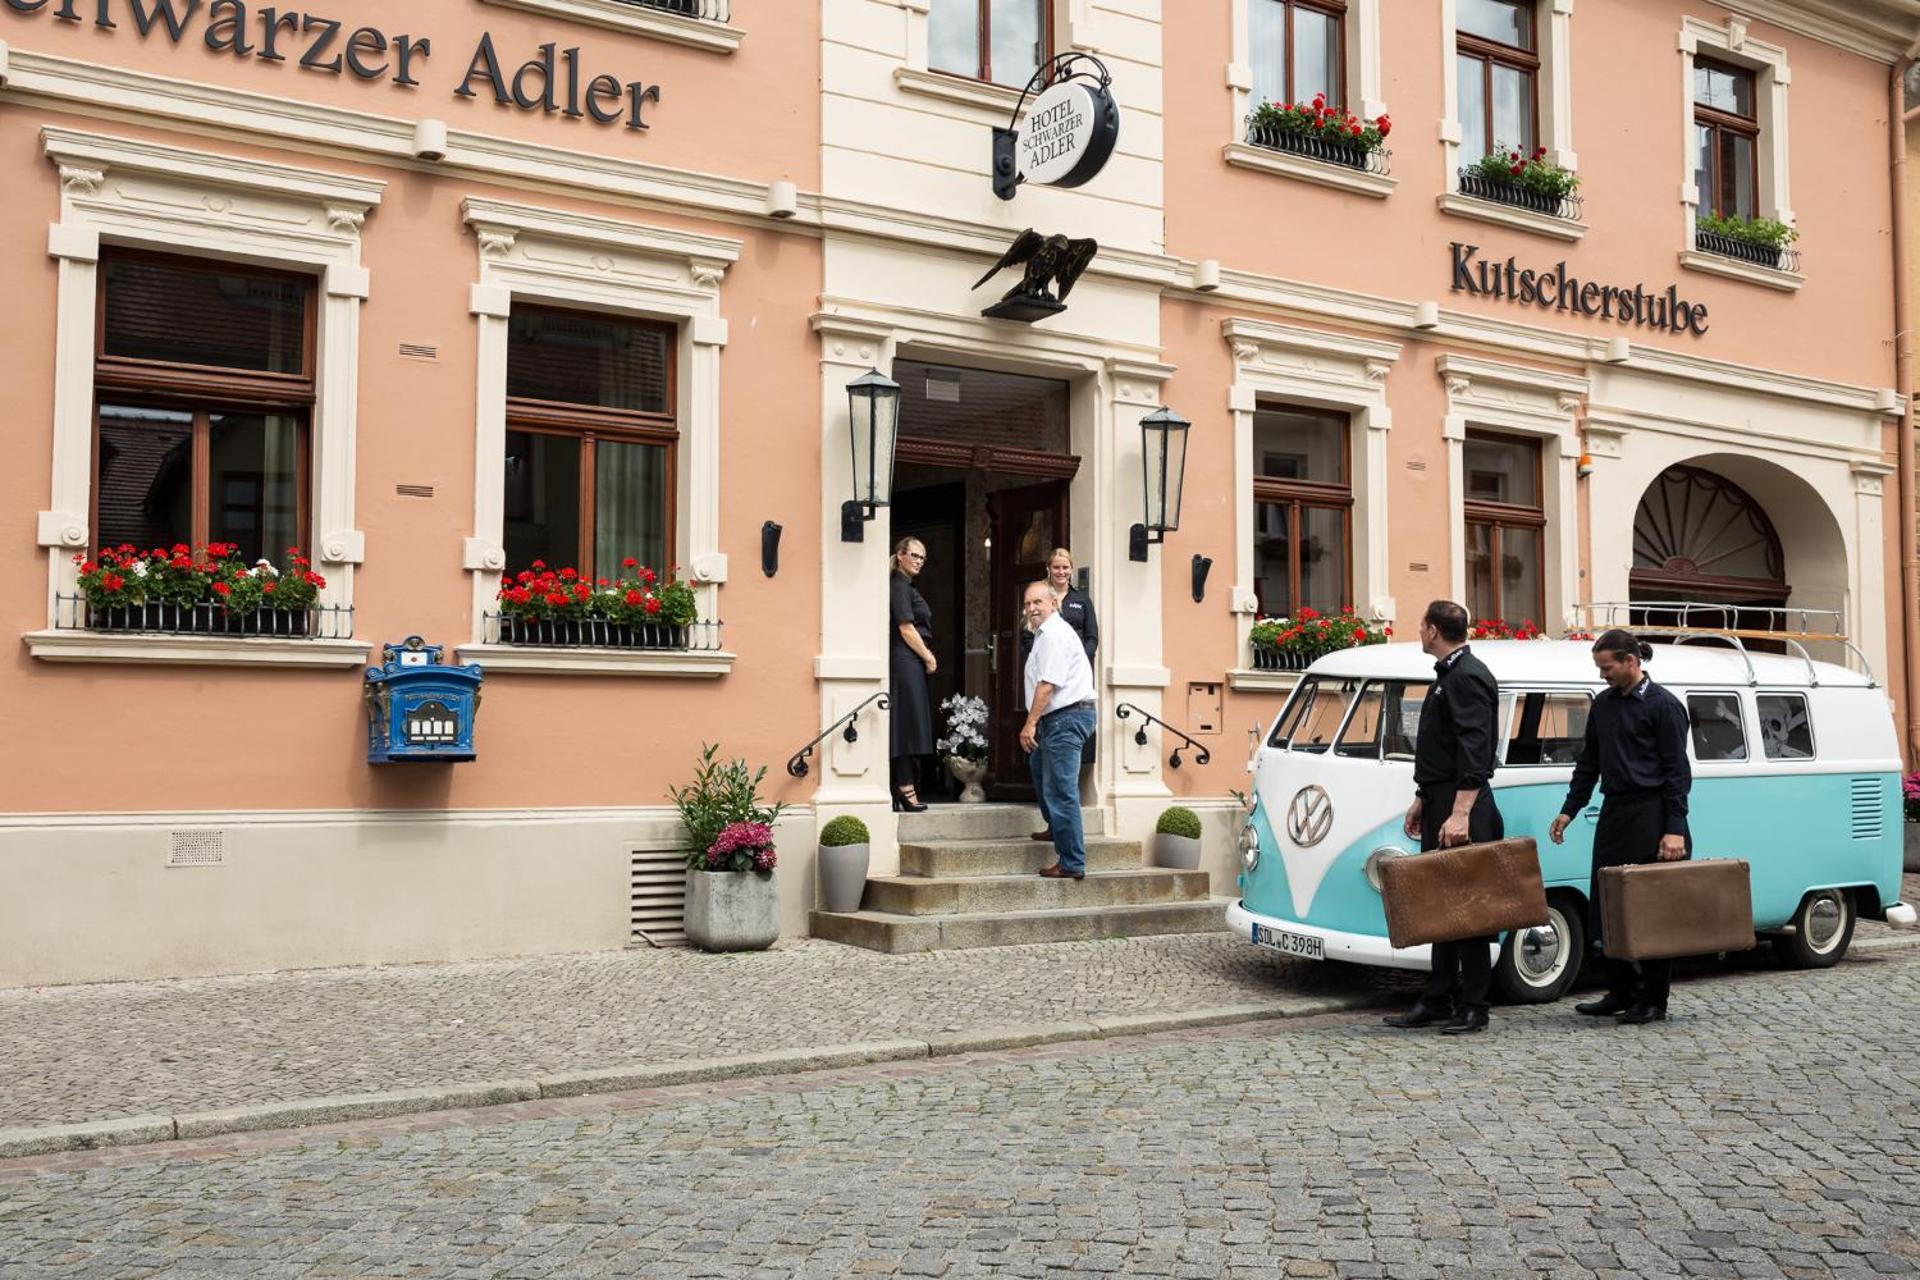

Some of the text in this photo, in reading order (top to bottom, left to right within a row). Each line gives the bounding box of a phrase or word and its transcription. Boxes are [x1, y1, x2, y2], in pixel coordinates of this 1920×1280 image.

[3, 0, 660, 129] warzer Adler
[1023, 113, 1083, 153] SCHWARZER
[1031, 99, 1074, 133] HOTEL
[1030, 132, 1076, 169] ADLER
[1450, 241, 1709, 335] Kutscherstube
